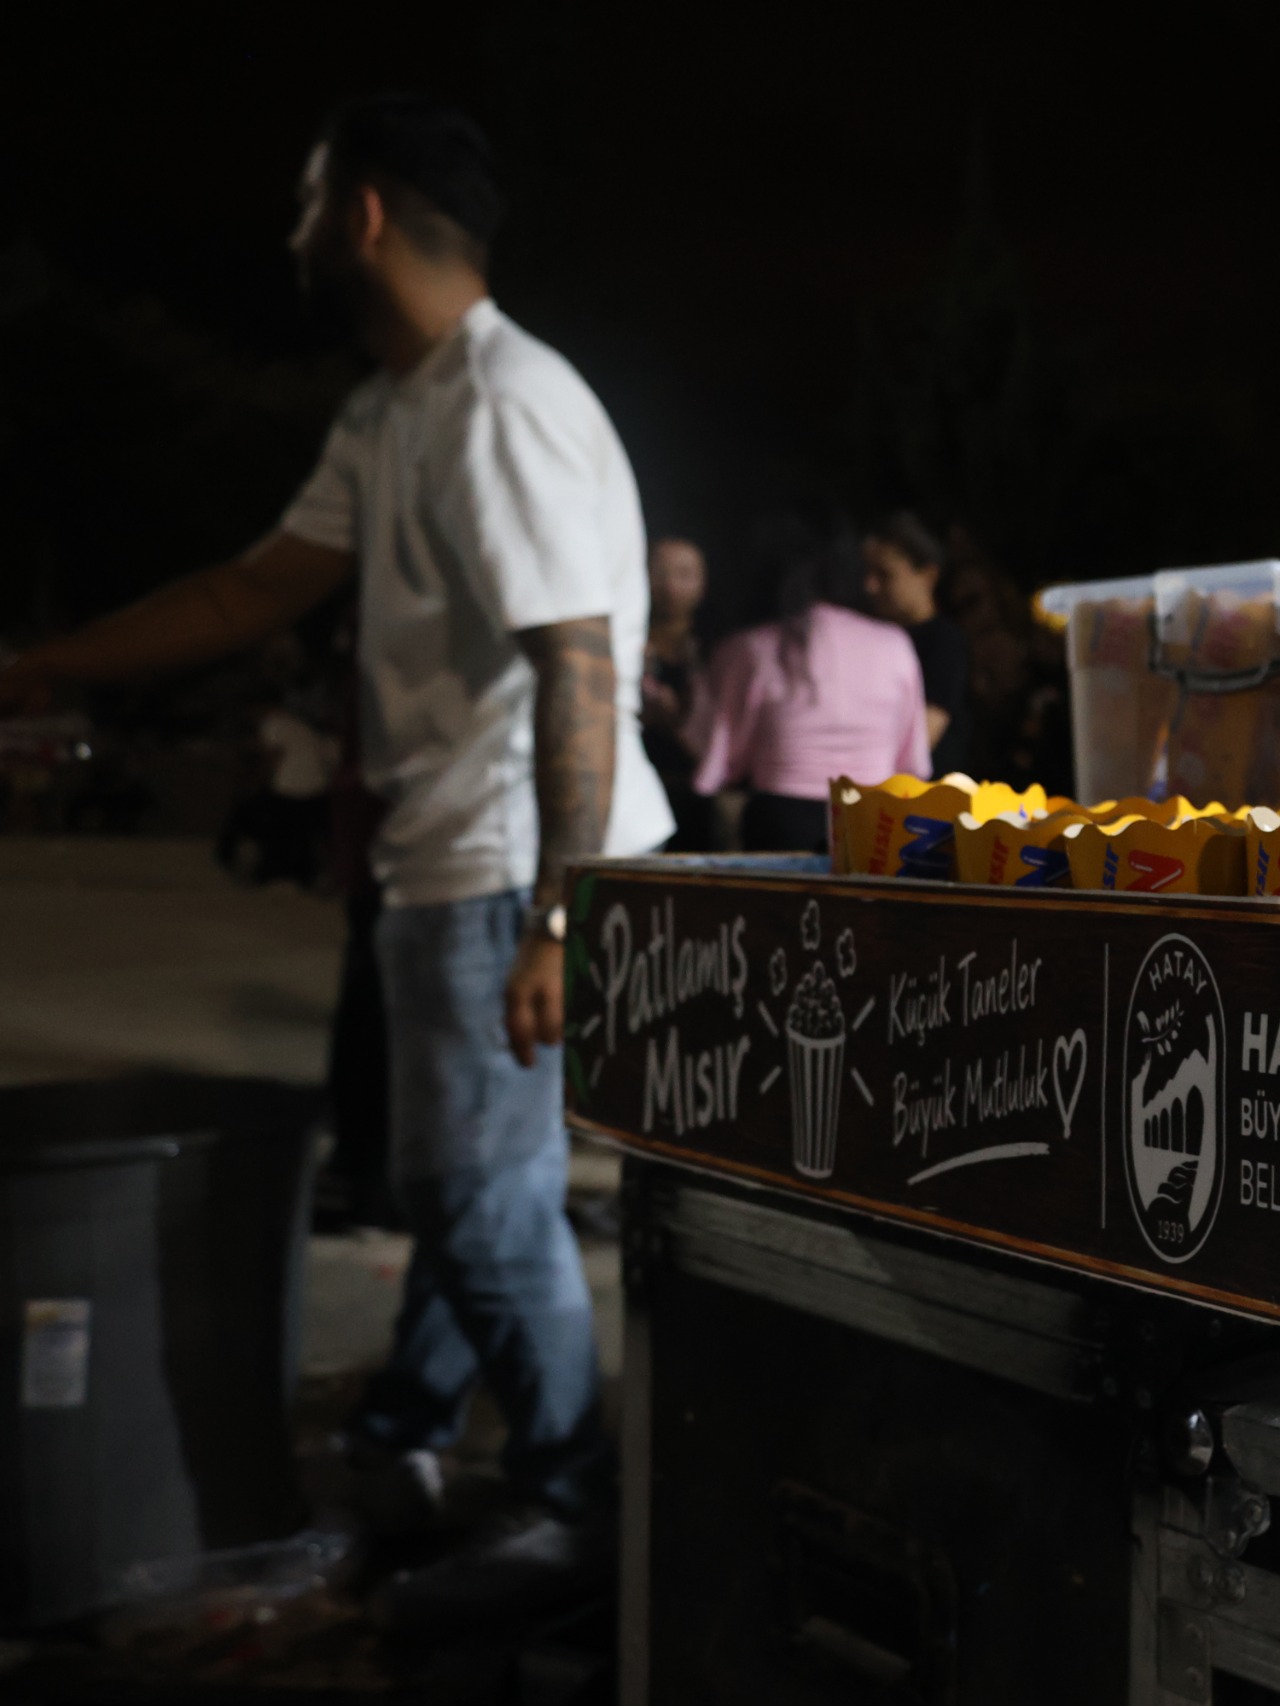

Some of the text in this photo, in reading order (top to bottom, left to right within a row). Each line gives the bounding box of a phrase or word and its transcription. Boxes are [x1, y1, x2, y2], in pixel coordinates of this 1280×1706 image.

[601, 896, 749, 1056] Patlamış
[887, 937, 1043, 1048] Küçük Taneler
[1149, 951, 1208, 996] HATAY
[643, 1025, 751, 1138] Mısır
[893, 1038, 1049, 1160] Büyük Mutluluk
[1157, 1219, 1186, 1245] 1939
